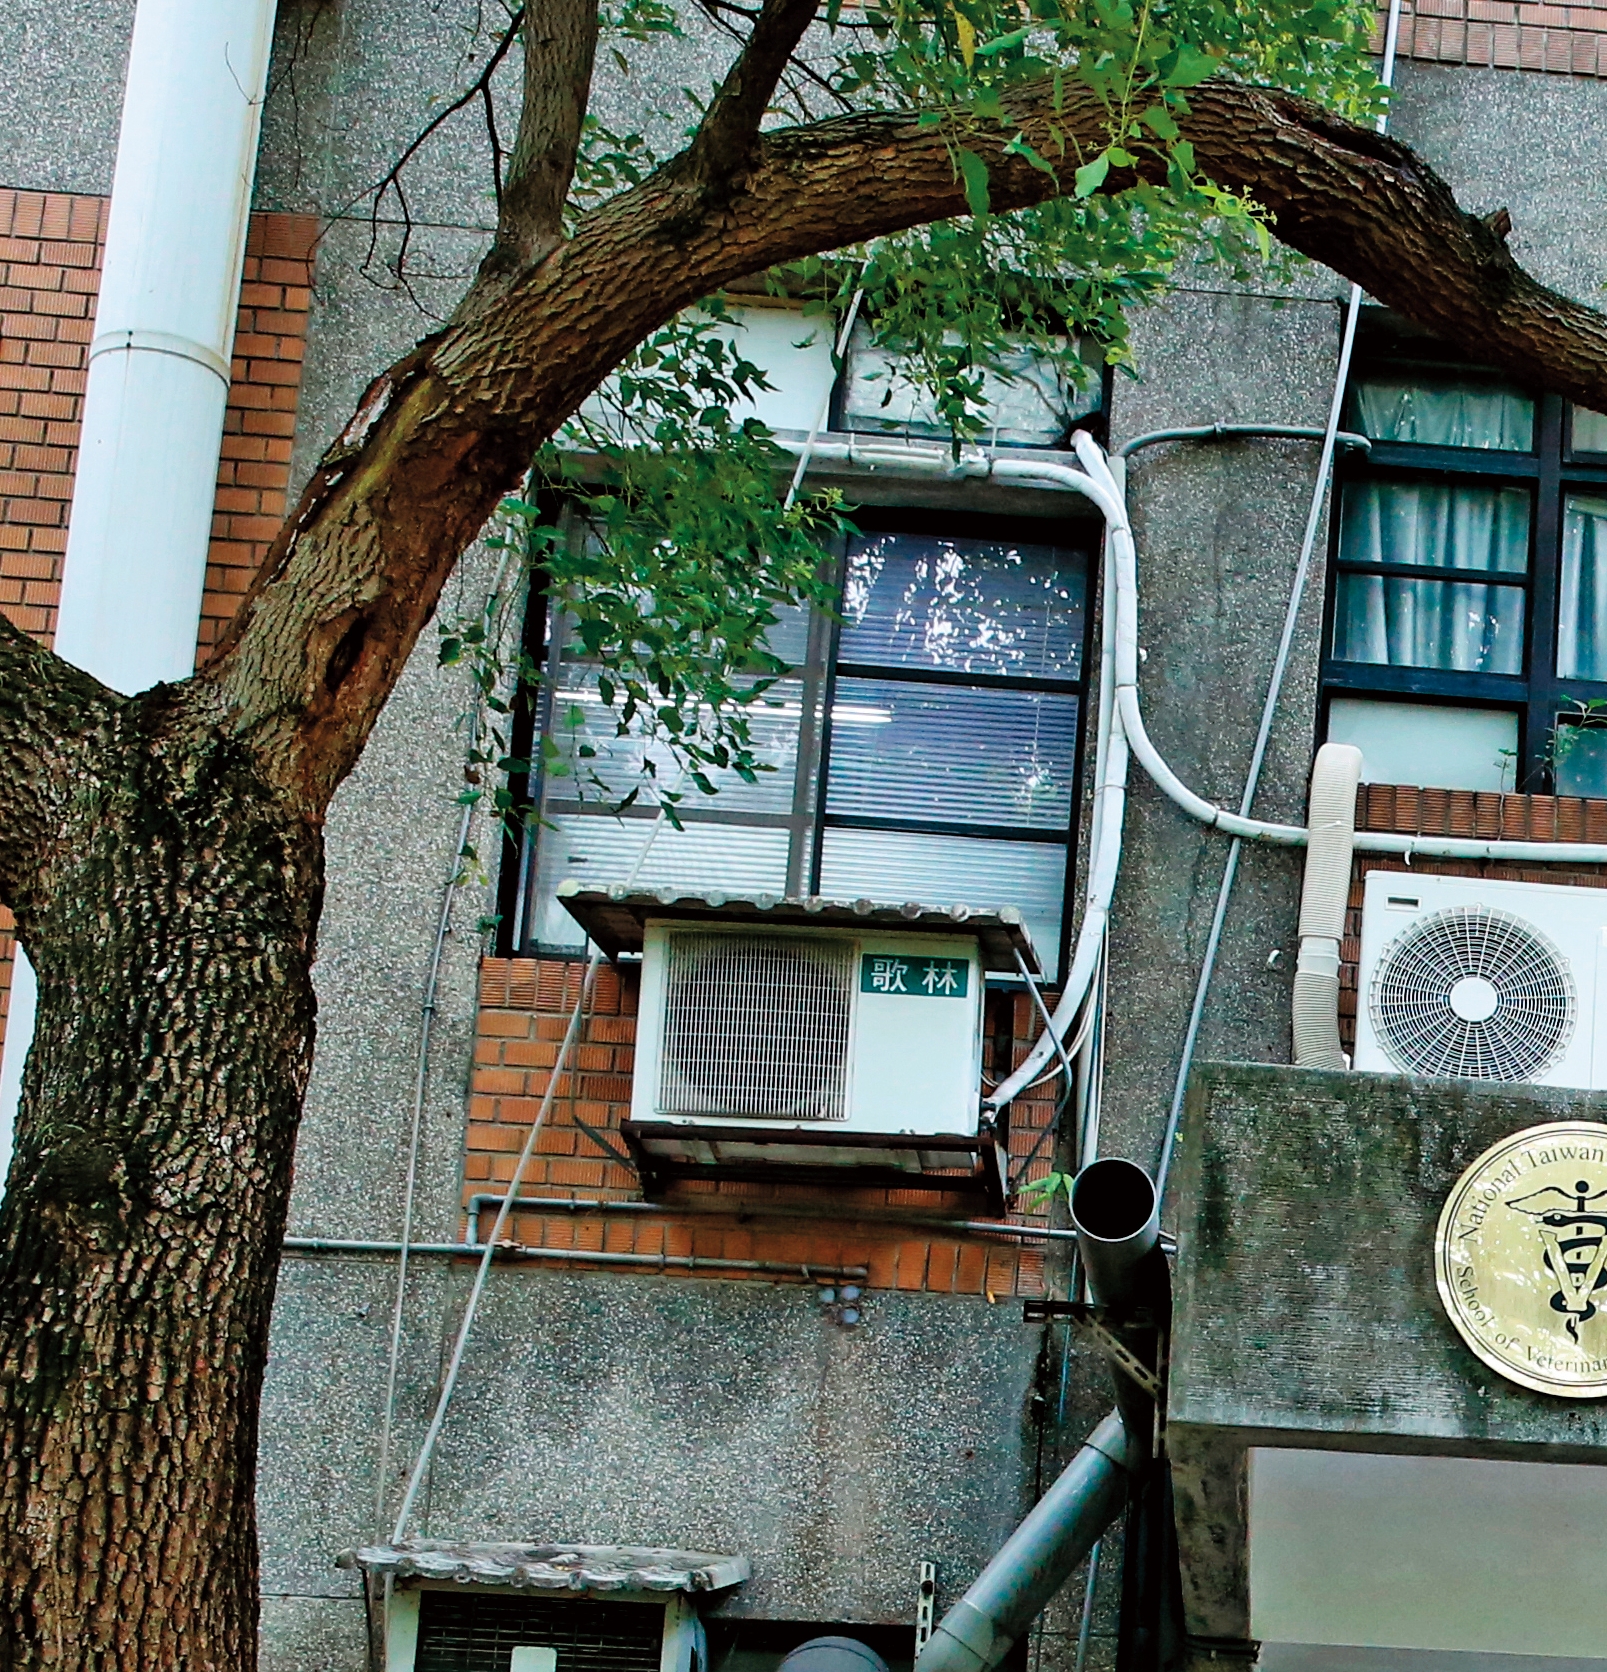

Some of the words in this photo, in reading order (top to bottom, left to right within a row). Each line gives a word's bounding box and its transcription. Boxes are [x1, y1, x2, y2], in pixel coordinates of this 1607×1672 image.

[870, 957, 958, 995] 歌林
[1458, 1158, 1522, 1244] National
[1522, 1143, 1605, 1171] Taiwan
[1456, 1264, 1497, 1330] School
[1495, 1331, 1520, 1352] of
